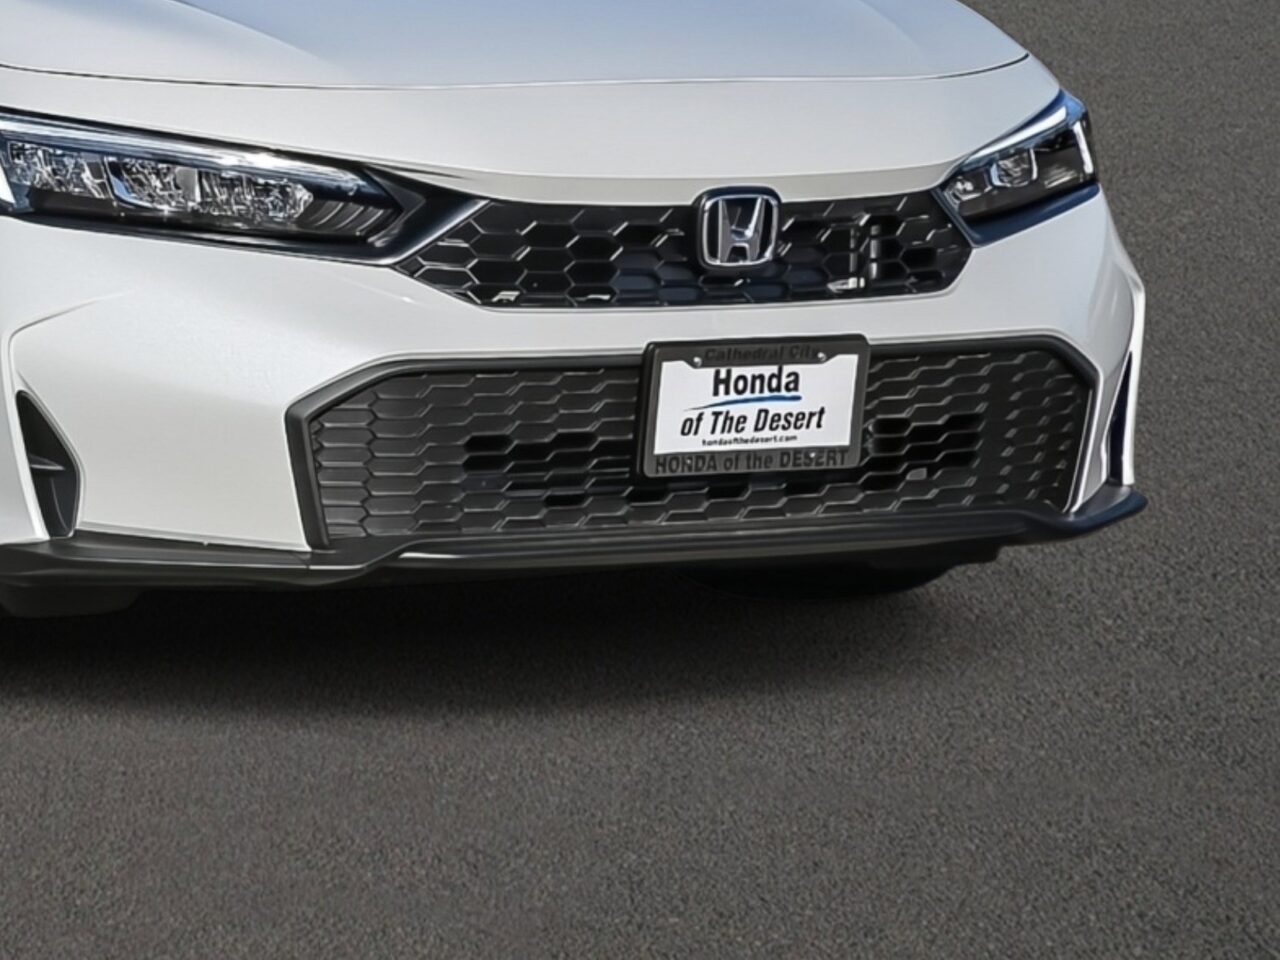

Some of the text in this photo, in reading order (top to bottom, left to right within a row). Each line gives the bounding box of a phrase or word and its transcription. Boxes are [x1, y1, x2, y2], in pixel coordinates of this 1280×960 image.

[712, 365, 801, 397] Honda
[680, 406, 826, 437] of The Desert
[654, 447, 850, 475] HONDA of the DESERT
